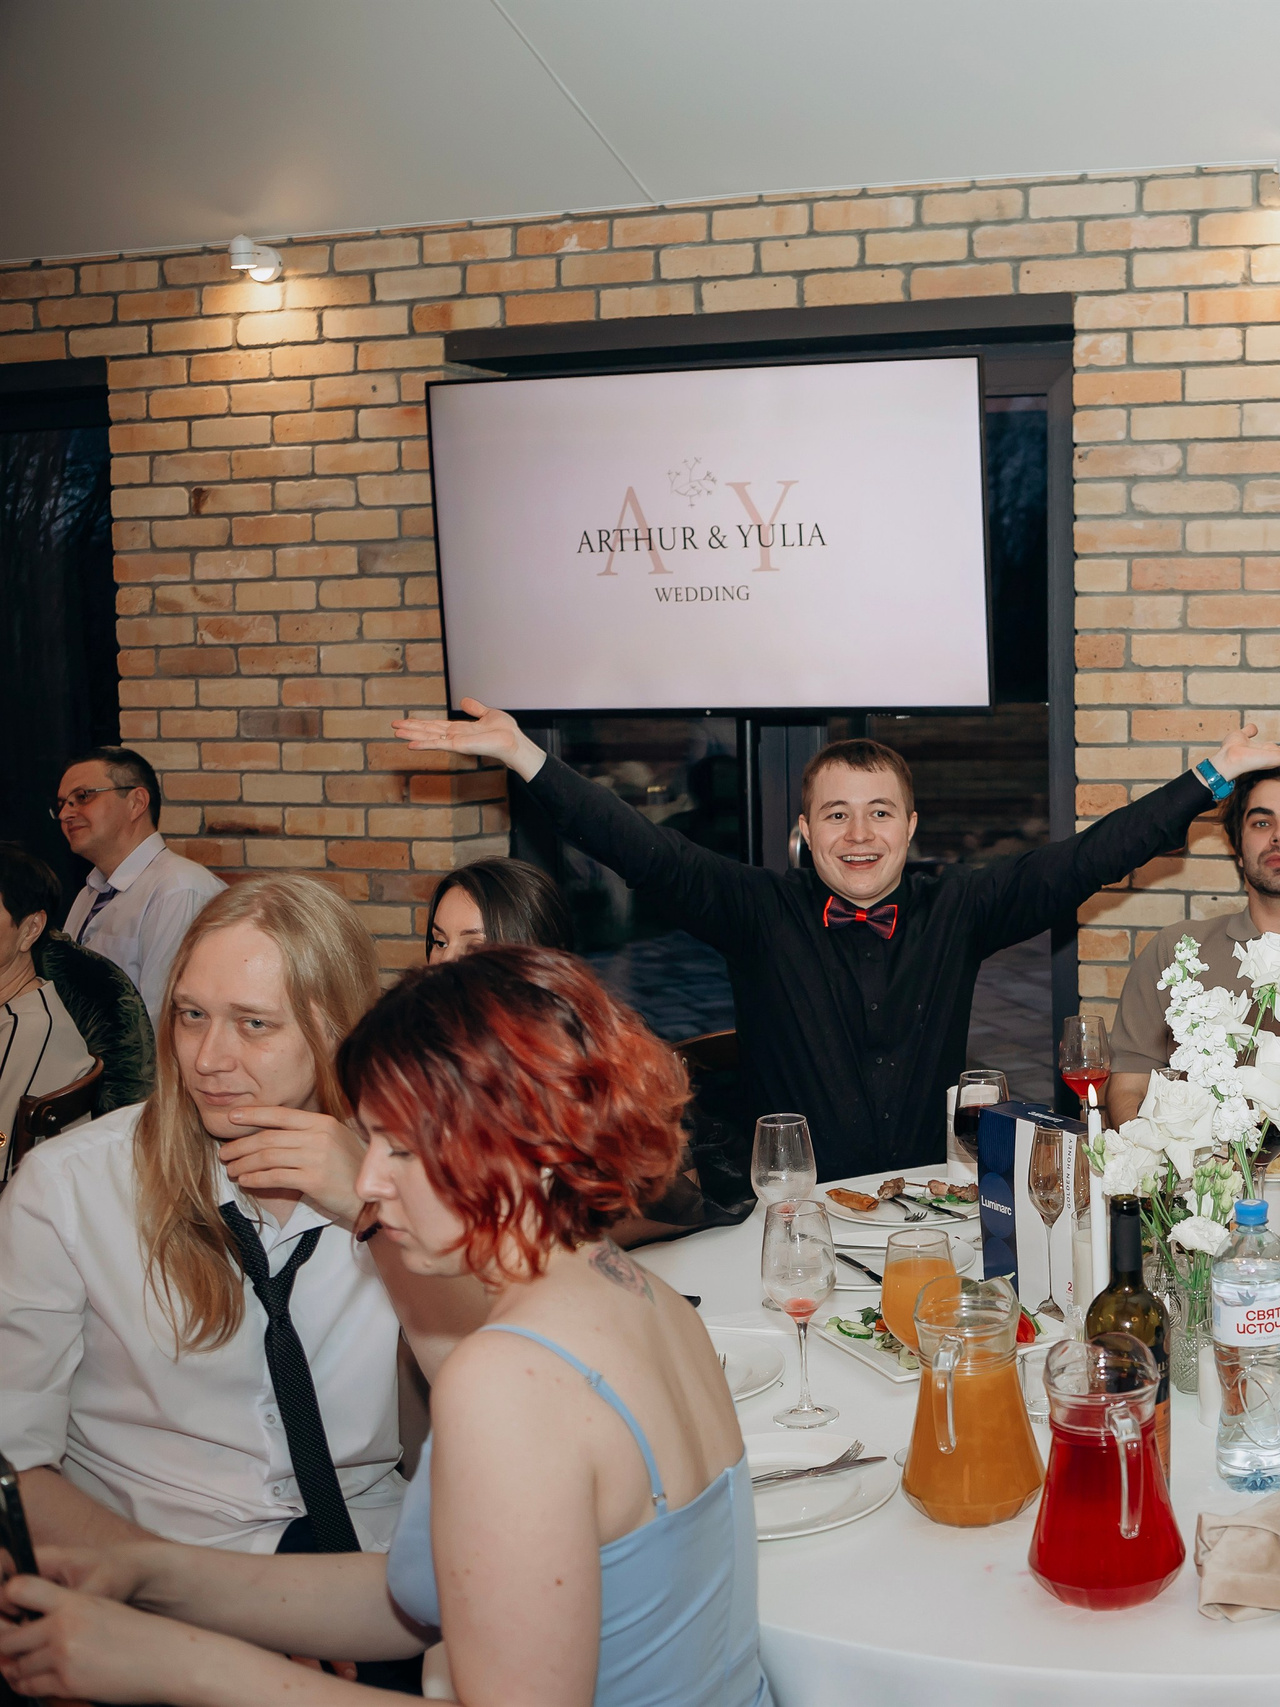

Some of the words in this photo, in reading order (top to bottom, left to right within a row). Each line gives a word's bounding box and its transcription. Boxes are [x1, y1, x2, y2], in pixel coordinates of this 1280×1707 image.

[576, 525, 699, 554] ARTHUR
[708, 525, 728, 549] &
[736, 522, 828, 549] YULIA
[596, 485, 674, 577] A
[725, 479, 800, 573] Y
[654, 584, 751, 603] WEDDING
[980, 1194, 1012, 1216] Luminarc
[1067, 1281, 1073, 1292] 2
